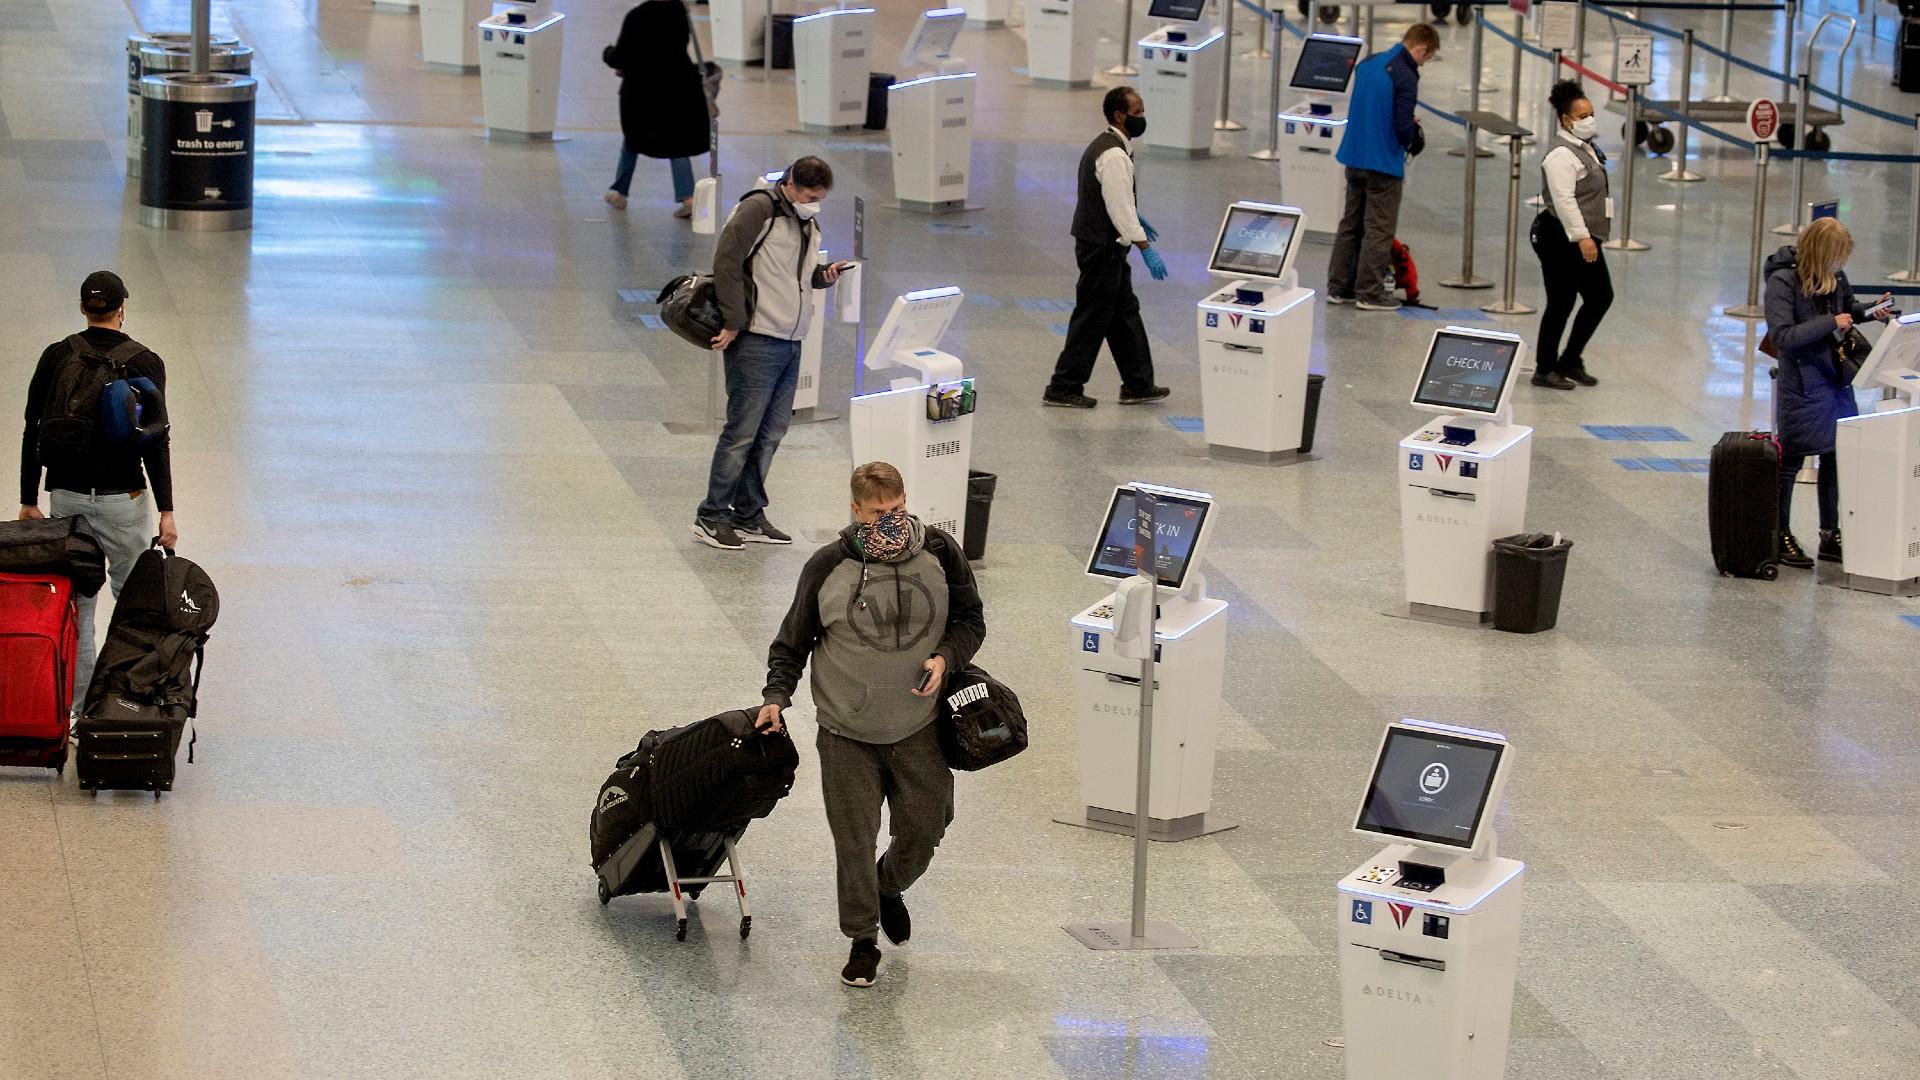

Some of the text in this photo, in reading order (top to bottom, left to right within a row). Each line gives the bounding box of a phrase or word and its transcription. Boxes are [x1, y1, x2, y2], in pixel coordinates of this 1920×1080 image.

[177, 139, 244, 150] trash to energy
[1446, 356, 1495, 371] CHECK IN
[1426, 514, 1459, 526] DELTA
[1166, 525, 1181, 537] IN
[861, 589, 915, 639] W
[947, 682, 990, 712] PUMA
[1376, 986, 1422, 1004] DELTA
